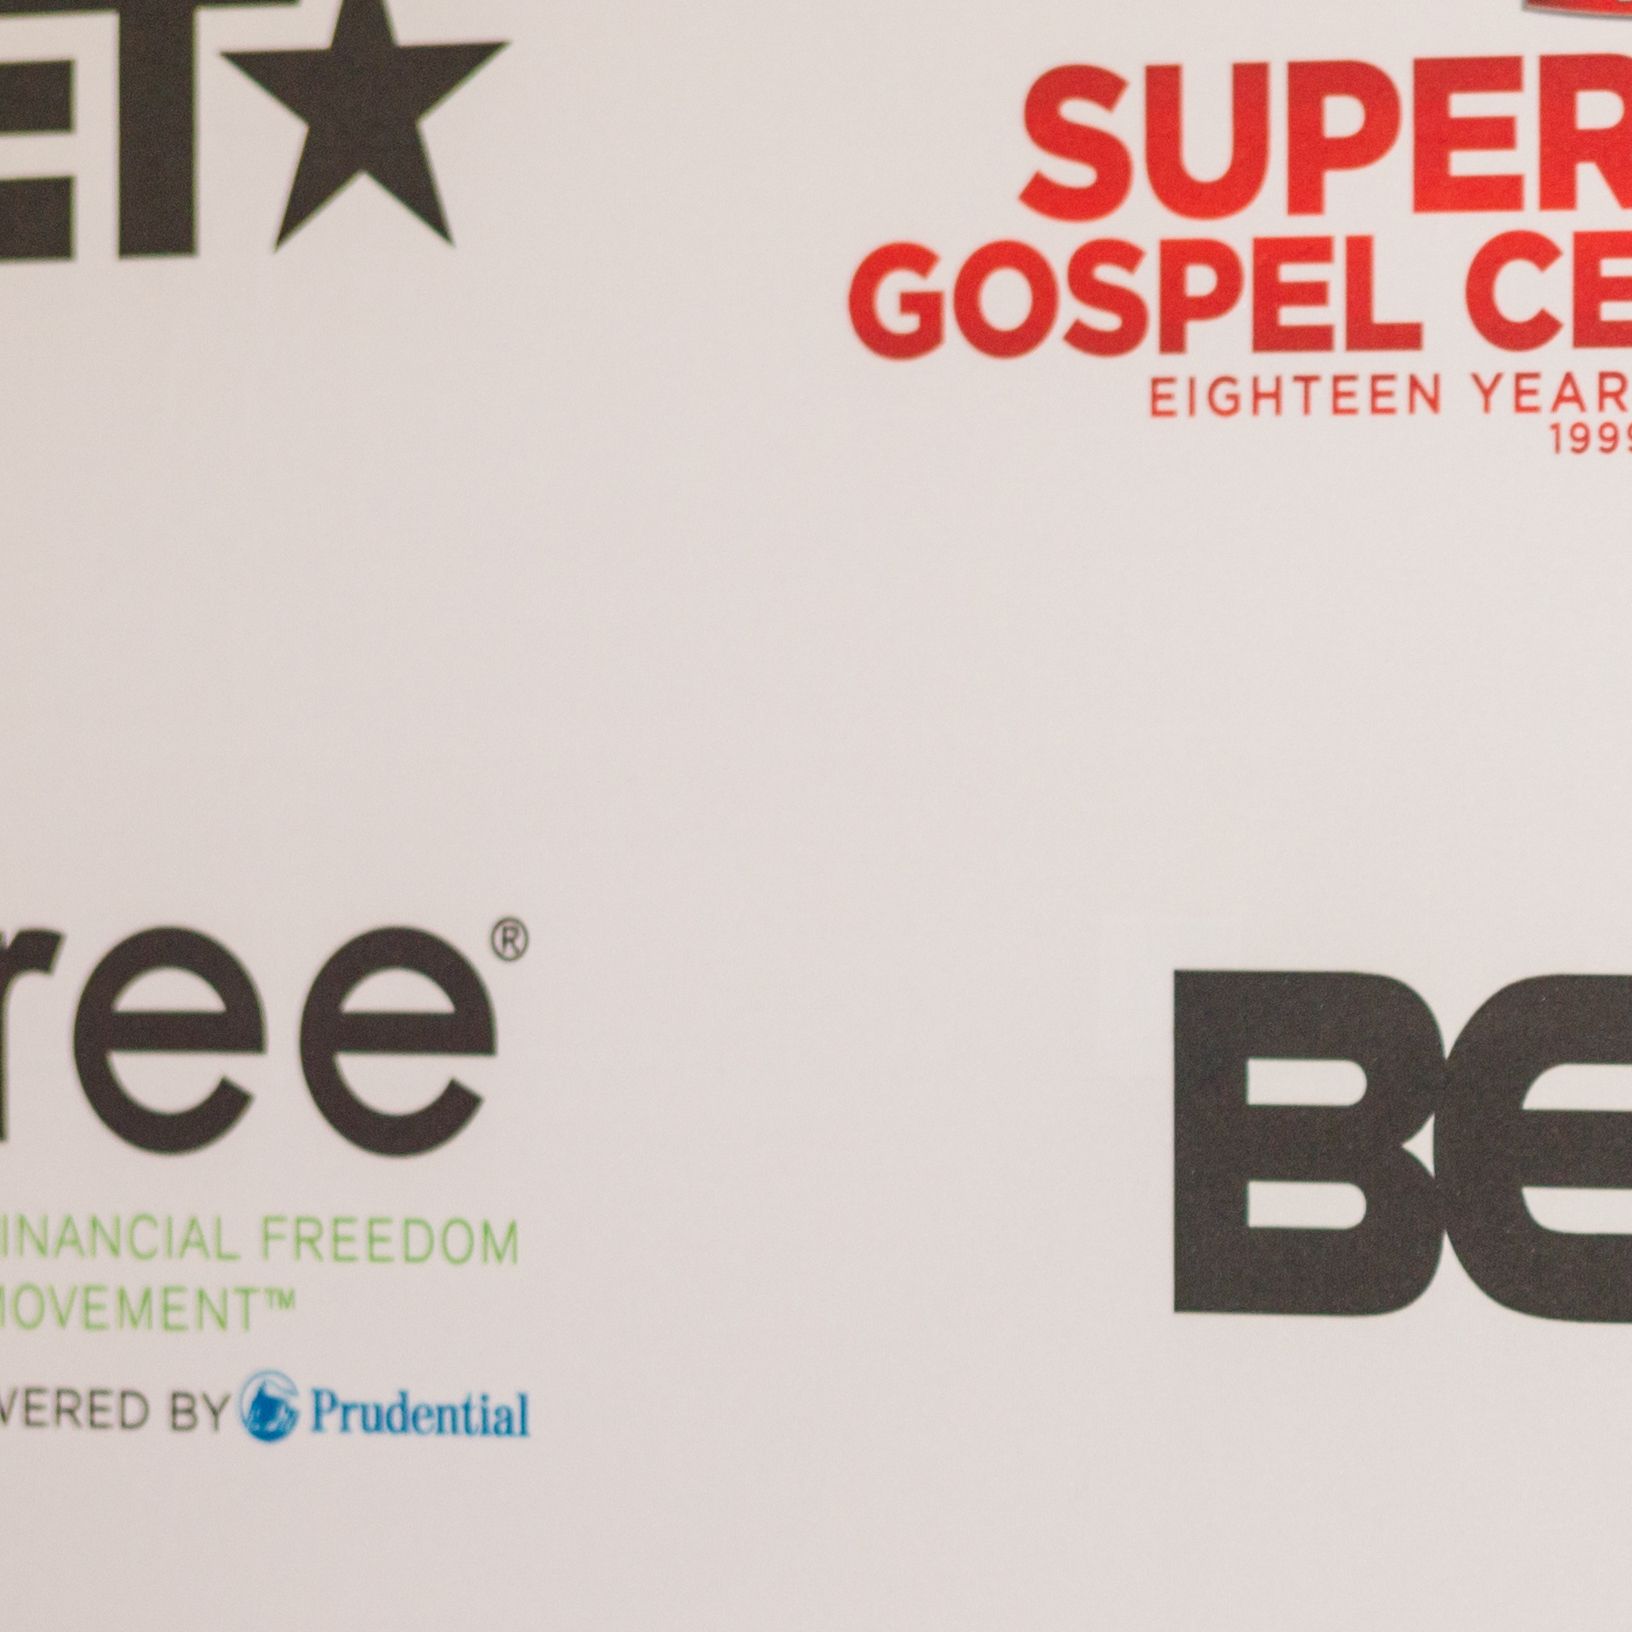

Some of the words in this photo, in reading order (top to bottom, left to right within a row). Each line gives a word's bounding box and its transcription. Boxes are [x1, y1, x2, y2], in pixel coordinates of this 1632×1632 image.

[848, 235, 1423, 360] GOSPEL
[1151, 374, 1440, 418] EIGHTEEN
[261, 1215, 518, 1265] FREEDOM
[0, 1283, 295, 1333] OVEMENT™
[170, 1391, 230, 1432] BY
[312, 1388, 528, 1437] Prudential
